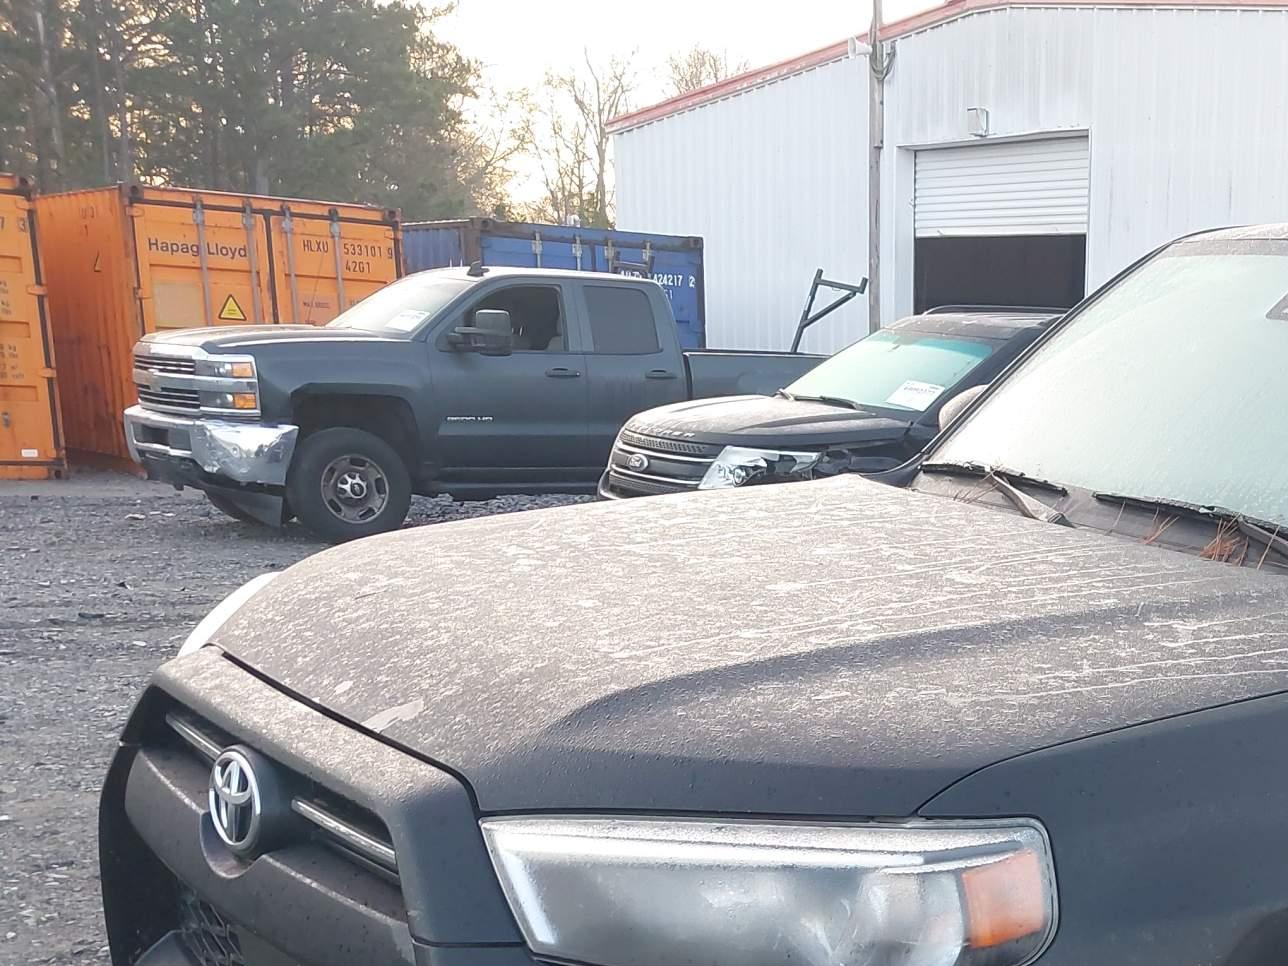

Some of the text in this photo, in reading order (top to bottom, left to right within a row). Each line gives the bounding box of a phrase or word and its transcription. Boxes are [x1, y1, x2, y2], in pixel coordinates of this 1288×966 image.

[148, 238, 247, 258] Hapag Lloyd
[303, 239, 329, 253] HLXU
[343, 243, 382, 258] 533101
[345, 260, 371, 273] 42G1
